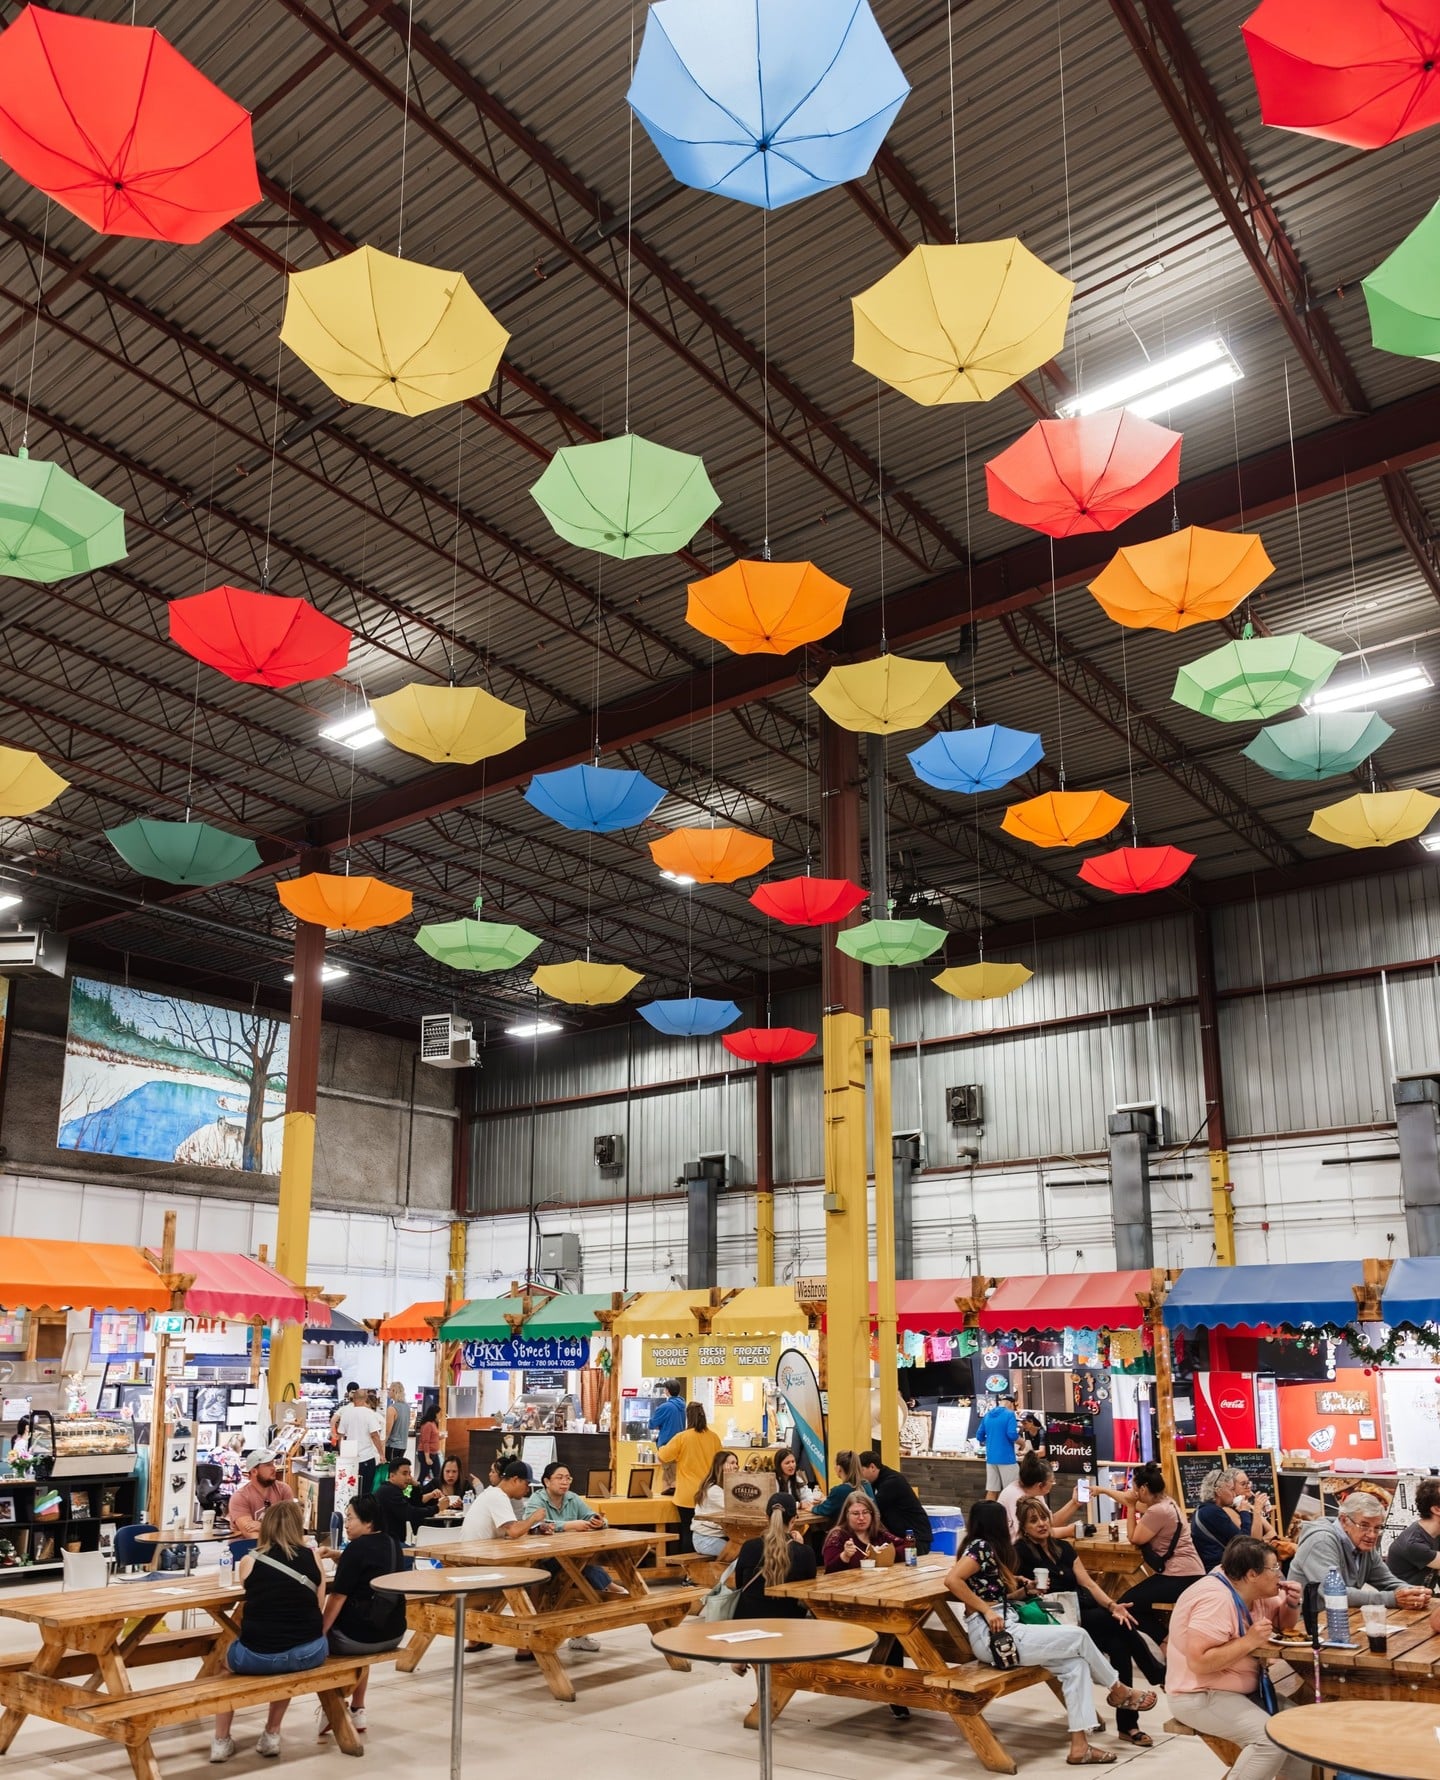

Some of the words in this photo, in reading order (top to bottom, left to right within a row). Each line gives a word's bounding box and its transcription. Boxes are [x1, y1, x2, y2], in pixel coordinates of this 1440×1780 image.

[797, 1280, 827, 1298] Washroo
[474, 1340, 505, 1361] BKK
[511, 1339, 551, 1358] Street
[556, 1339, 582, 1359] Food
[652, 1348, 688, 1357] NOODLE
[698, 1346, 726, 1356] FRESH
[733, 1346, 771, 1356] FROZEN
[656, 1357, 687, 1367] BOWLS
[700, 1356, 725, 1366] BAOS
[738, 1356, 769, 1366] MEALS
[1321, 1399, 1366, 1414] Breakfast
[1049, 1444, 1092, 1456] PiKanté
[734, 1486, 760, 1495] ITALIAN
